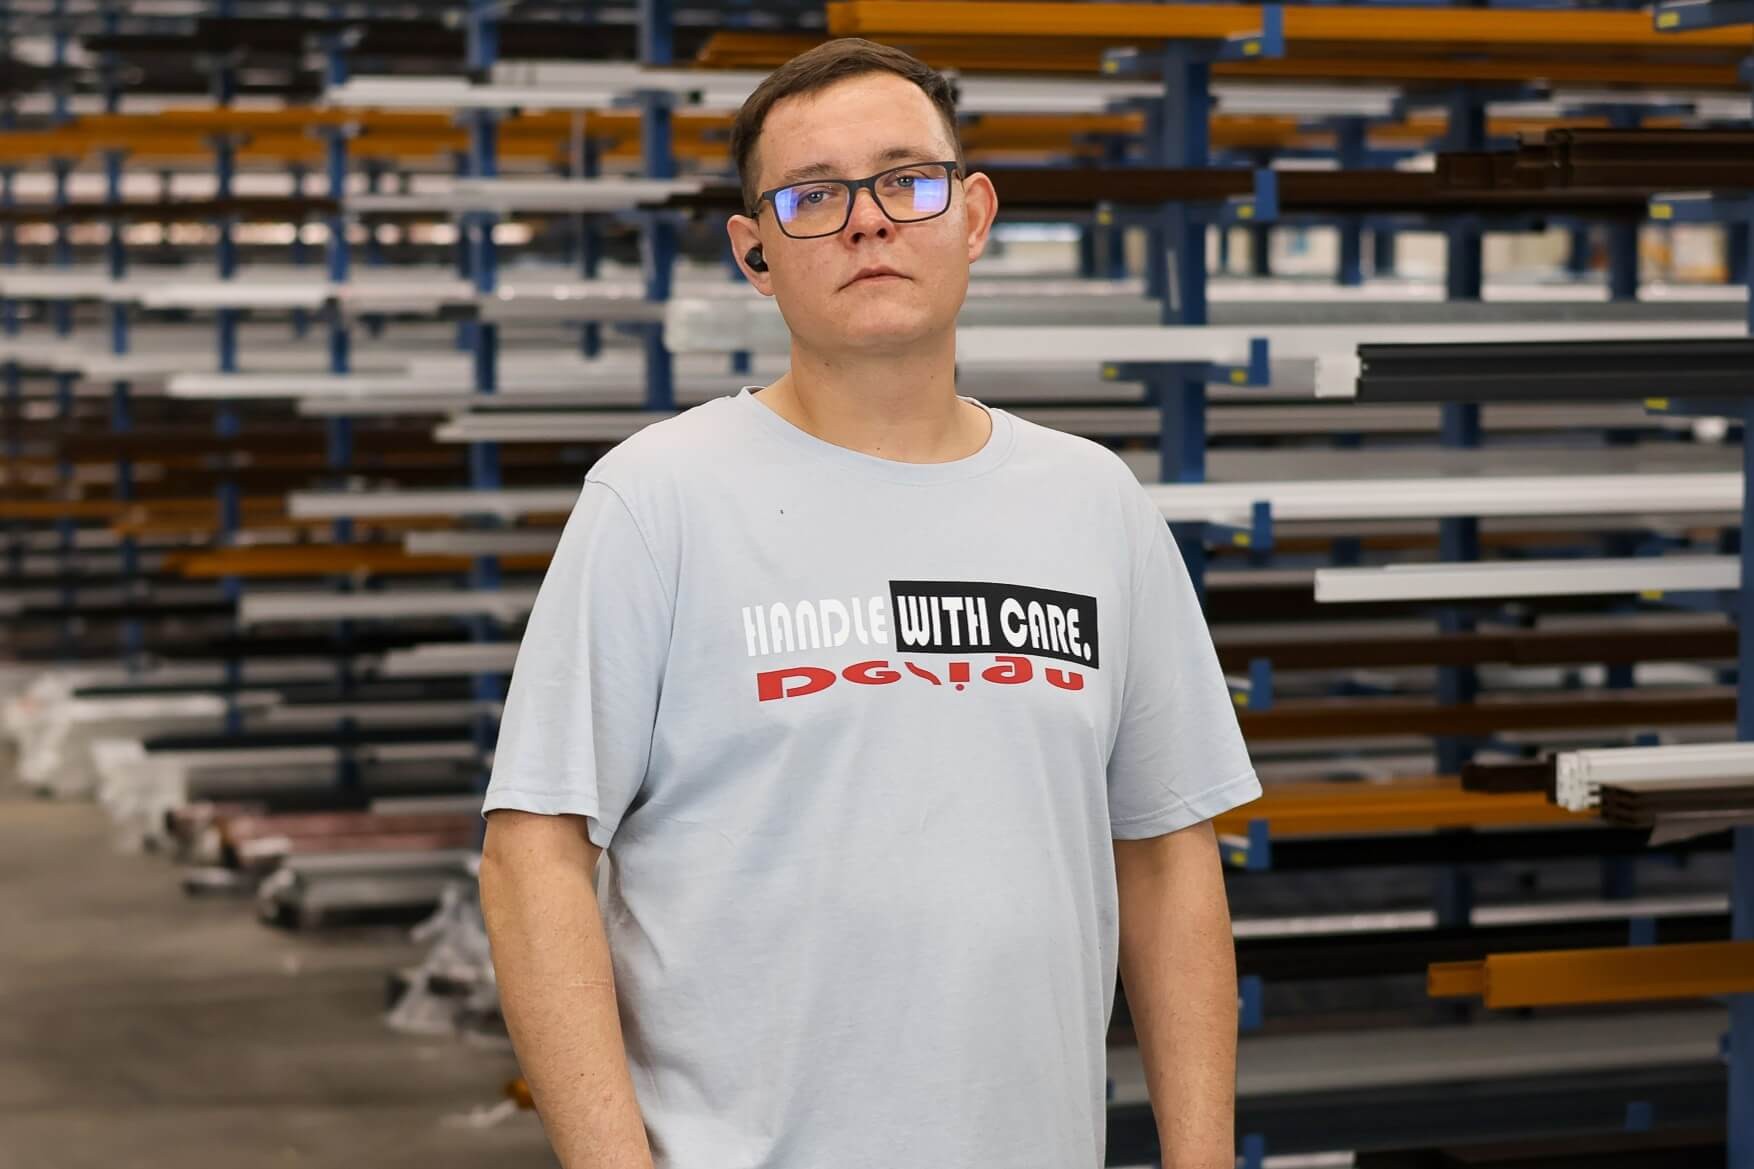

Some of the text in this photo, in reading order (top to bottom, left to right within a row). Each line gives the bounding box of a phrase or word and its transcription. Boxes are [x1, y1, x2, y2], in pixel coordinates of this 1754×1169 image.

[742, 595, 1092, 661] HANDLE WITH CARE.
